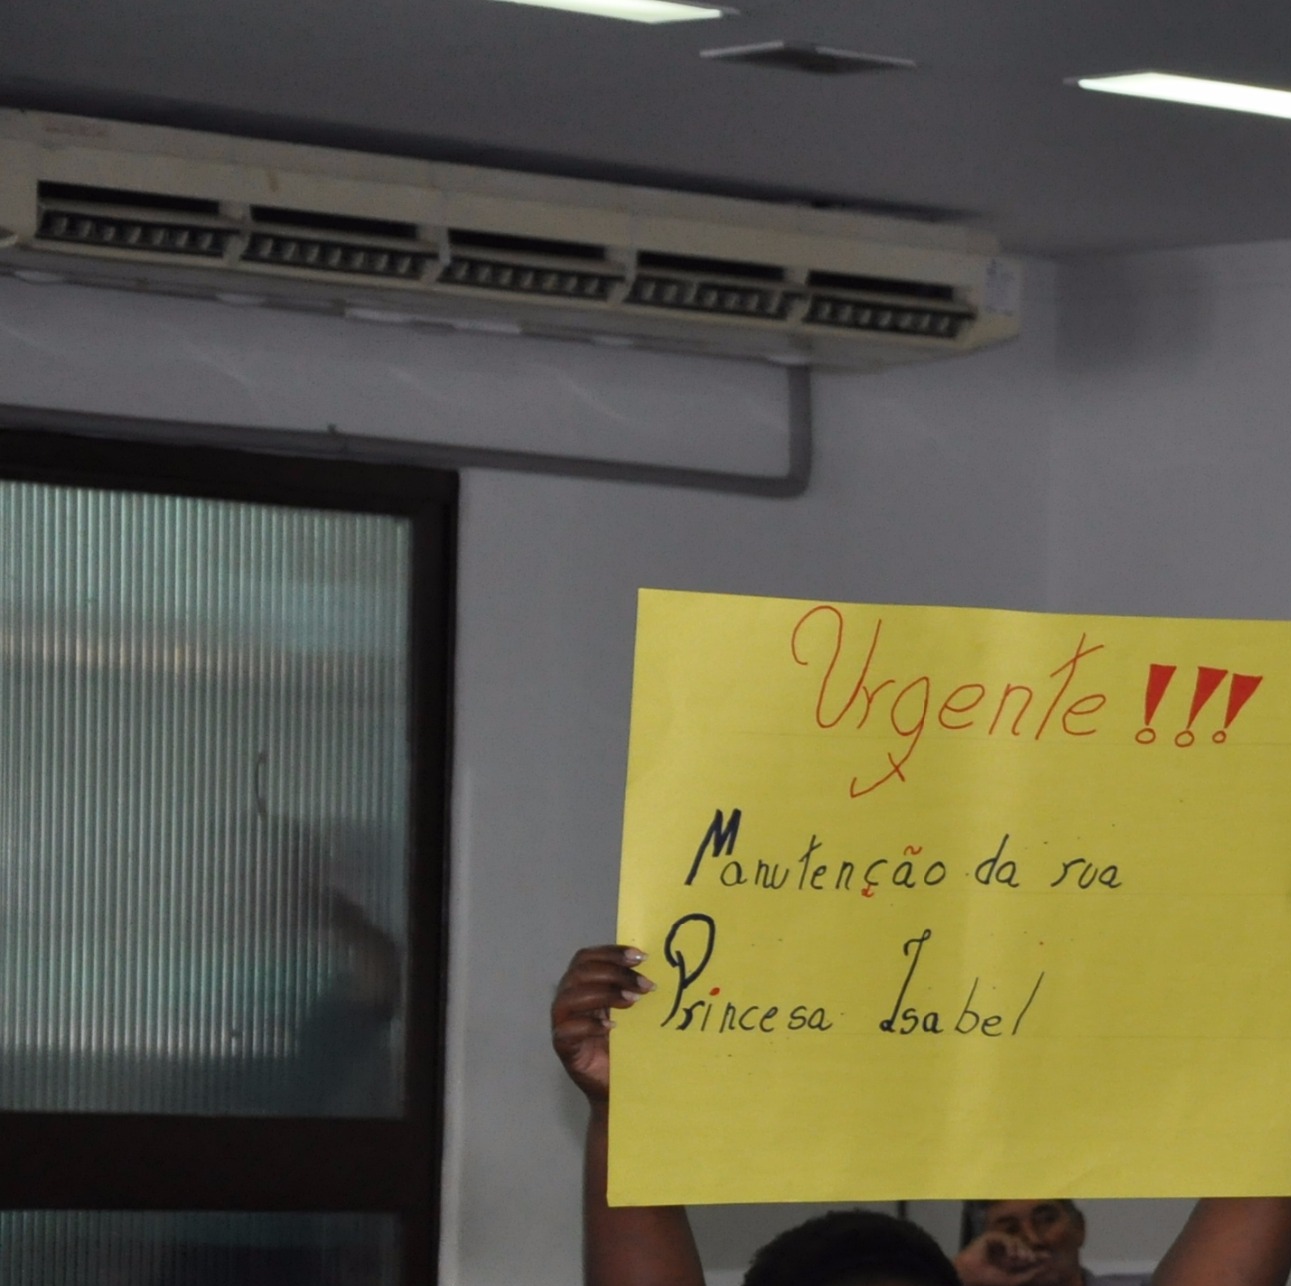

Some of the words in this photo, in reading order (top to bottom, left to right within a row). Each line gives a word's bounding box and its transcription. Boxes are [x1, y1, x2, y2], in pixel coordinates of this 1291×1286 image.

[791, 606, 1106, 798] Urgente
[684, 808, 946, 898] Manutenção
[975, 834, 1020, 888] da
[1050, 858, 1122, 889] rua
[660, 913, 833, 1033] Princesa
[879, 929, 1044, 1037] Isabel
